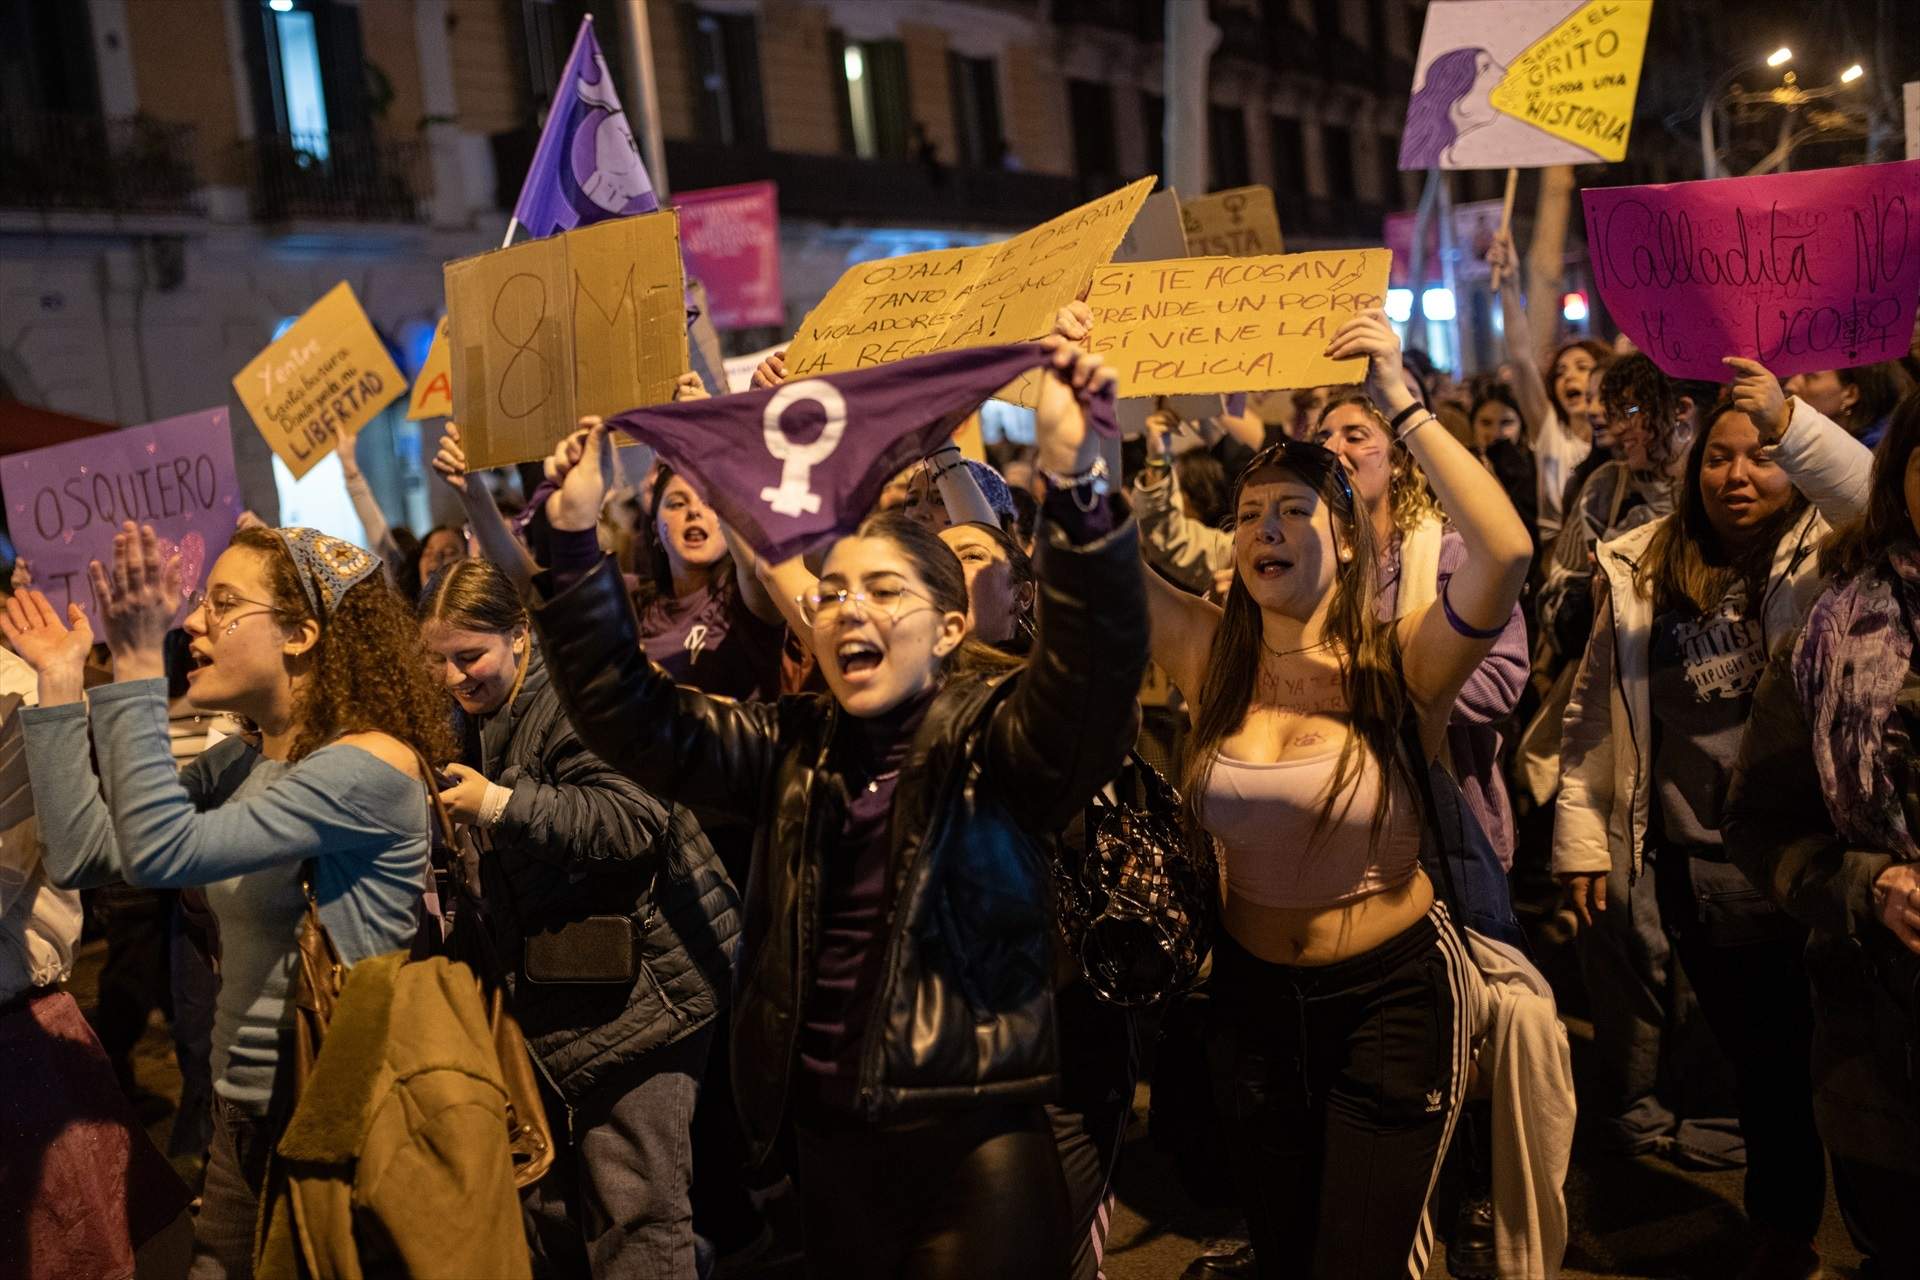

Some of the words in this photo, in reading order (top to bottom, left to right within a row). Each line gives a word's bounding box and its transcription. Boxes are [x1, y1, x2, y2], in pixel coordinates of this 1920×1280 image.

[1587, 5, 1621, 25] EL
[1527, 29, 1619, 87] GRITO
[1593, 74, 1626, 89] UNA
[1526, 101, 1626, 144] HISTORIA
[987, 244, 1021, 268] TE
[1854, 194, 1908, 293] NO
[863, 288, 947, 314] TANTO
[953, 267, 1017, 300] ASCO
[981, 269, 1065, 308] COMO
[1152, 268, 1195, 293] TE
[1205, 258, 1346, 290] ACOSAN
[1217, 295, 1266, 313] UN
[1278, 316, 1326, 339] LA
[795, 352, 833, 374] LA
[288, 371, 384, 461] LIBERTAD
